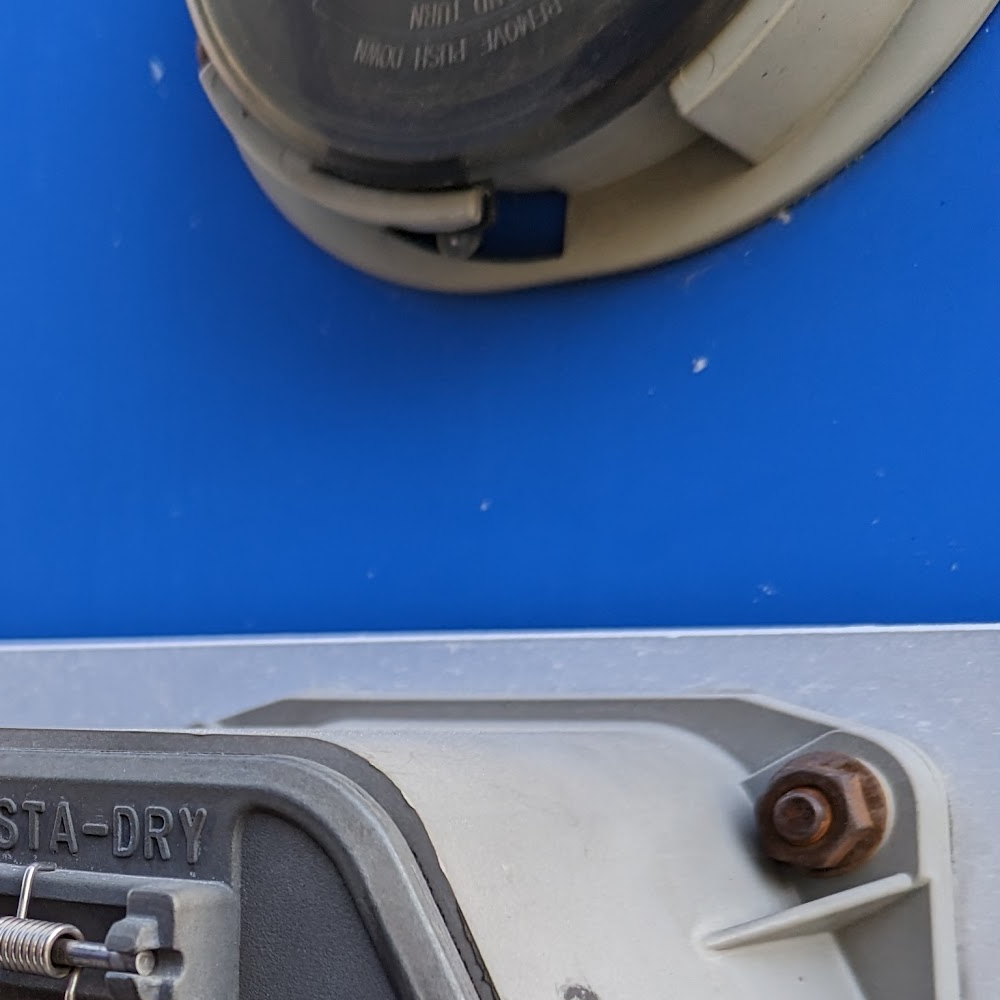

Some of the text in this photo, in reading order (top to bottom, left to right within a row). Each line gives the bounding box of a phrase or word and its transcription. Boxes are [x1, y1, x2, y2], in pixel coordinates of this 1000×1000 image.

[409, 0, 460, 30] TURN
[353, 38, 403, 70] DOWN
[414, 38, 467, 71] PUSH
